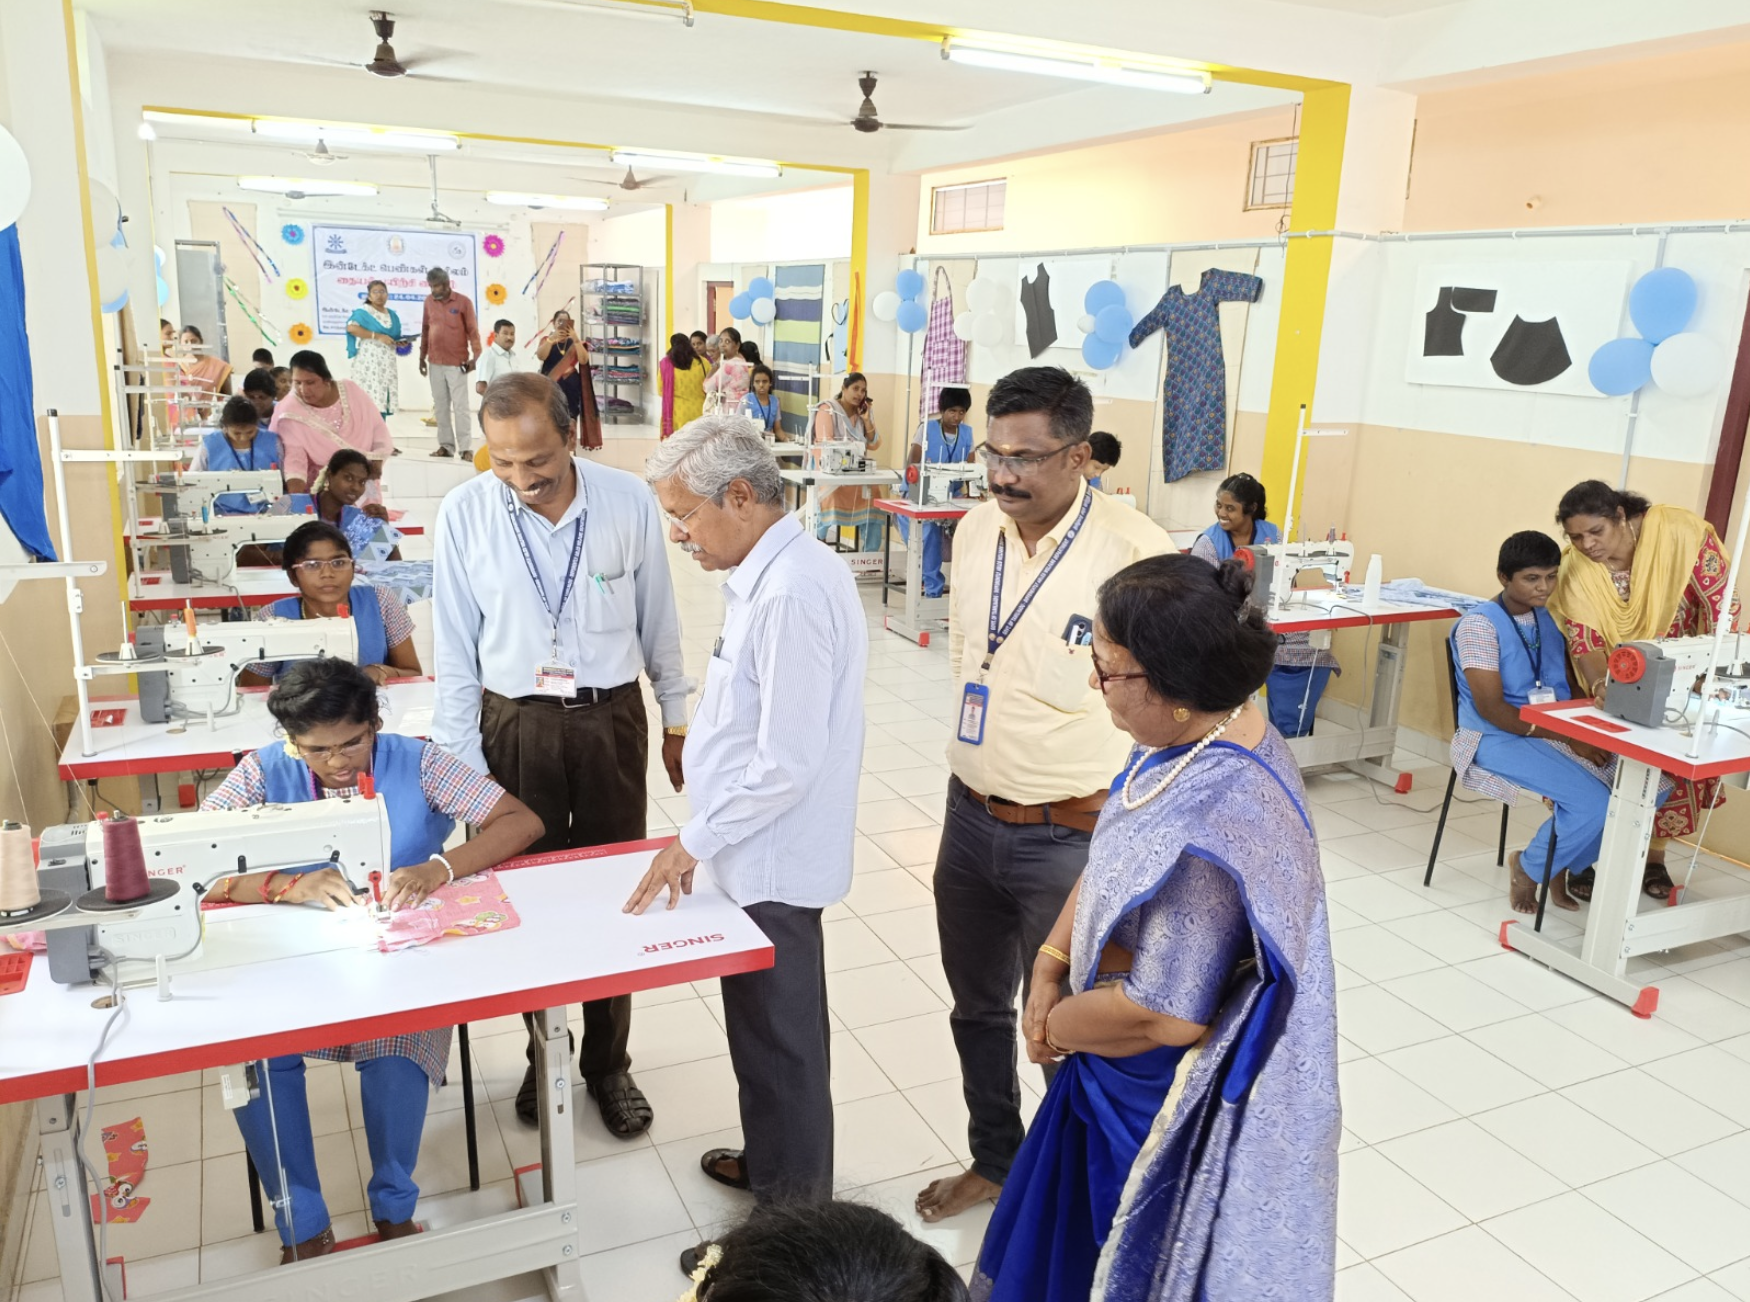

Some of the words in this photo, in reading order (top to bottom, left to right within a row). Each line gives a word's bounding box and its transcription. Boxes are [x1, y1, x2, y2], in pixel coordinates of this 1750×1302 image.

[850, 558, 884, 566] SINGER
[147, 866, 185, 878] NGER
[642, 933, 725, 953] SINGER
[264, 1262, 419, 1302] INGER
